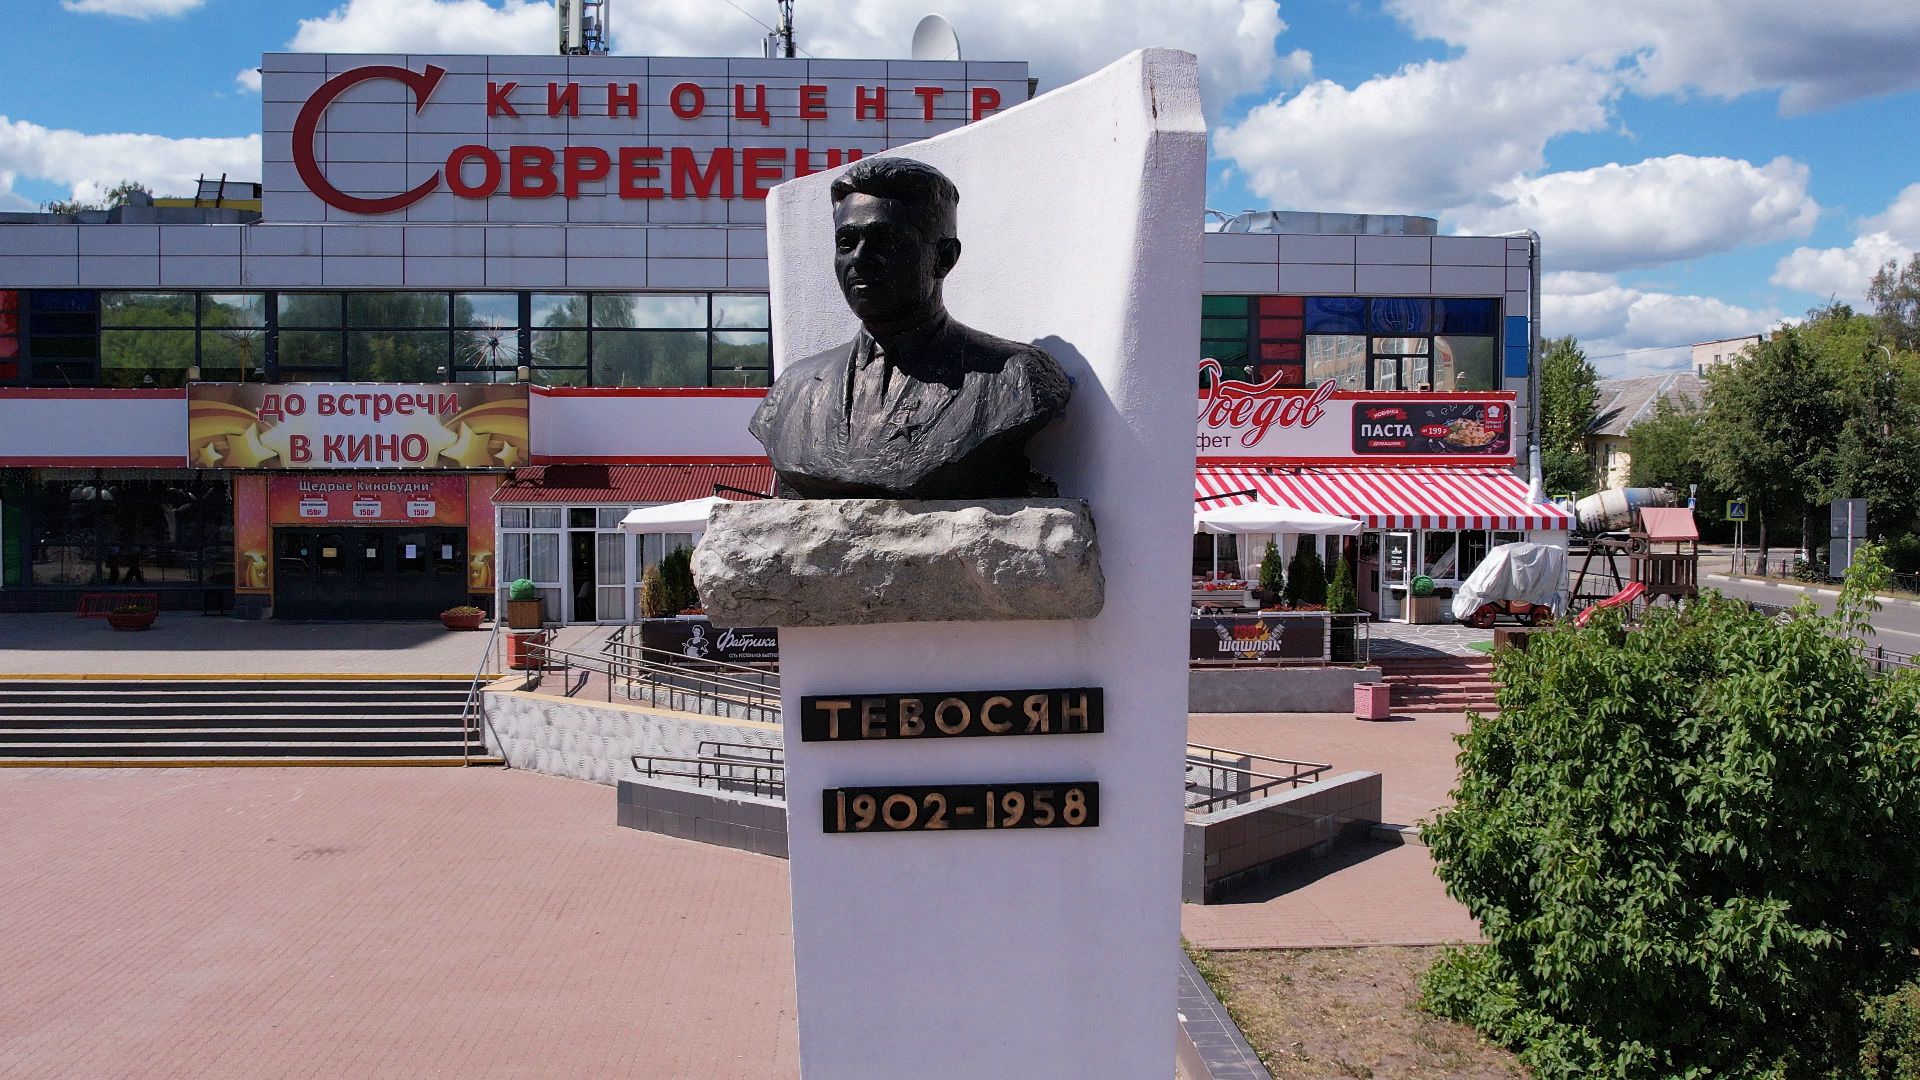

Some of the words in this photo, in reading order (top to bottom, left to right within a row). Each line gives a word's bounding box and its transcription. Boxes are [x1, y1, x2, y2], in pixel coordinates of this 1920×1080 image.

[488, 82, 1002, 126] КИНОЦЕНТР
[318, 392, 462, 422] встречи
[1361, 424, 1414, 437] ПАСТА
[1428, 427, 1442, 435] 199
[324, 433, 430, 462] КИНО
[299, 481, 353, 493] Щедрые
[716, 627, 777, 651] Фабрика
[1218, 640, 1282, 652] шашлык
[815, 692, 1089, 740] ТЕВОСЯН
[836, 787, 1088, 831] 1902-1958
